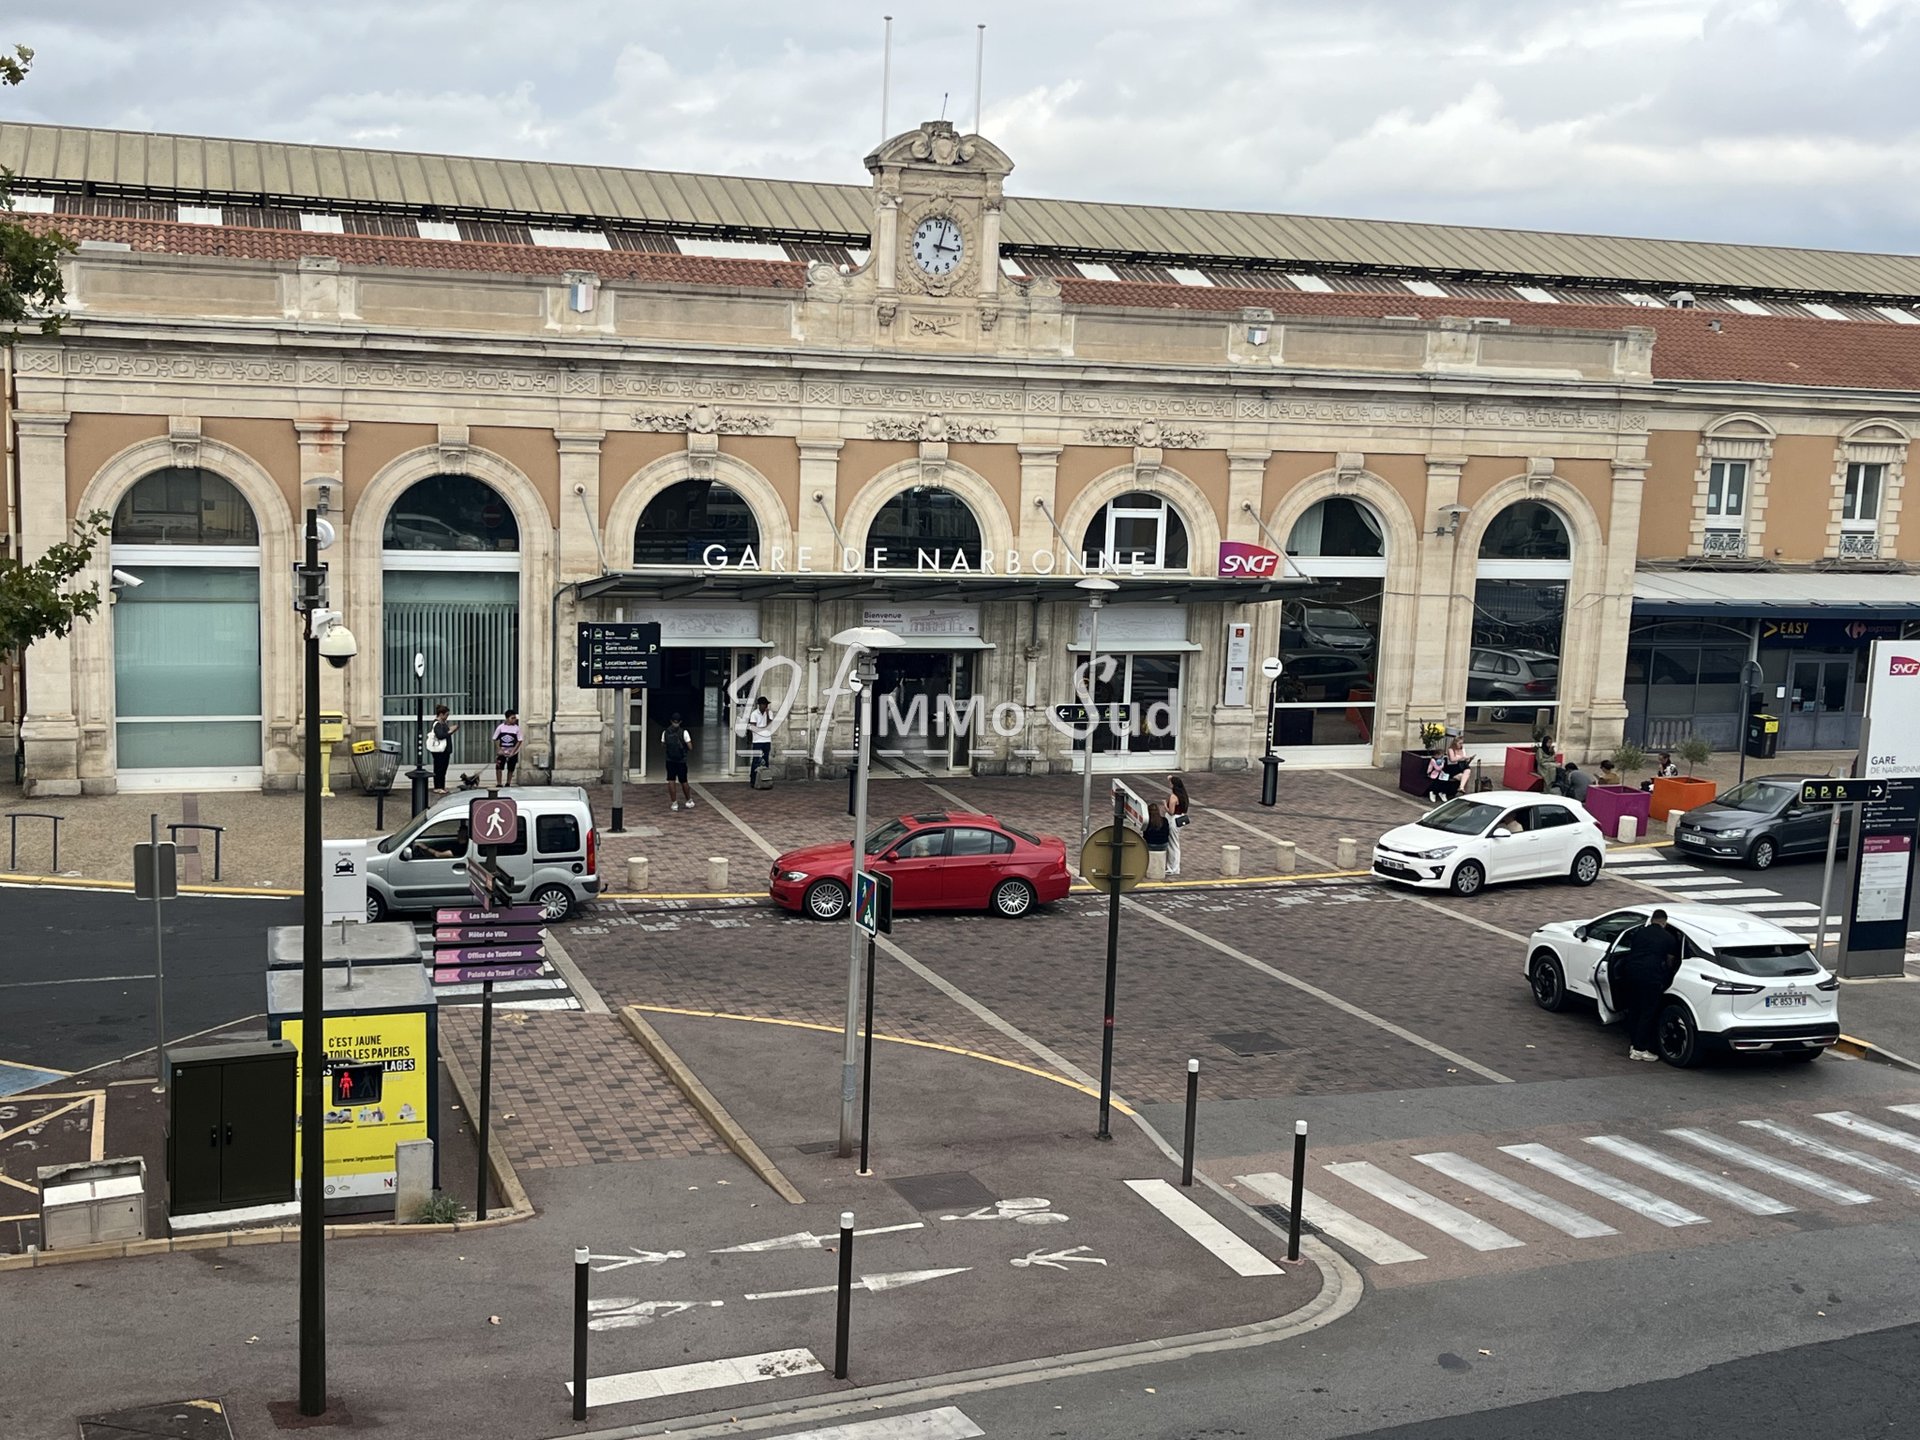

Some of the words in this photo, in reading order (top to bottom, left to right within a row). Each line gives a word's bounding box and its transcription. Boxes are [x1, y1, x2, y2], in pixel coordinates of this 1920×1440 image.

[926, 224, 932, 232] 11
[935, 221, 942, 229] 12
[914, 241, 920, 249] 9
[952, 254, 958, 262] 4
[944, 262, 950, 270] 5
[702, 544, 812, 572] GARE
[843, 547, 888, 573] DE
[917, 547, 1146, 576] NARBONNE
[1222, 555, 1277, 573] SNCF
[864, 611, 902, 619] Bienvenue
[1780, 622, 1810, 634] EASY
[1891, 663, 1919, 674] SNCF
[1870, 756, 1896, 765] GARE
[1870, 766, 1880, 774] DE
[329, 1036, 353, 1048] C'EST
[355, 1035, 382, 1047] JAUNE
[329, 1049, 352, 1059] TOUS
[353, 1049, 370, 1059] LES
[371, 1046, 410, 1059] PAPIERS
